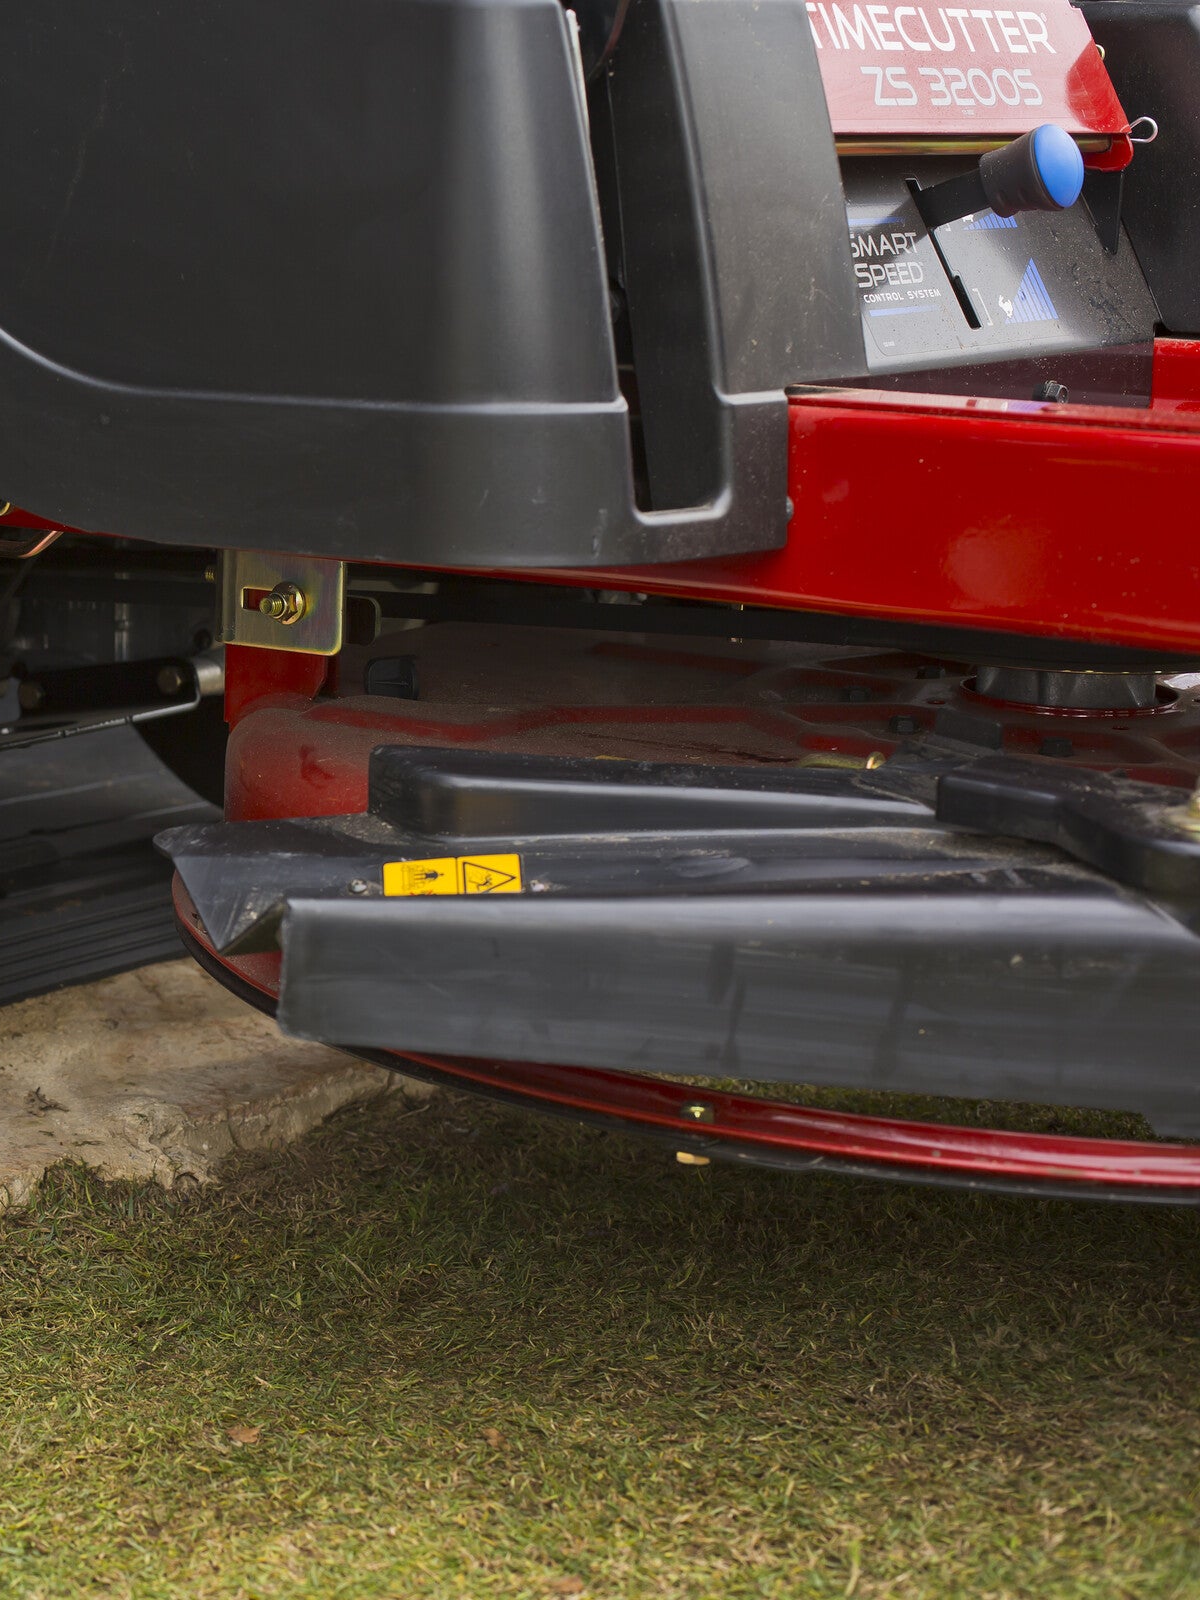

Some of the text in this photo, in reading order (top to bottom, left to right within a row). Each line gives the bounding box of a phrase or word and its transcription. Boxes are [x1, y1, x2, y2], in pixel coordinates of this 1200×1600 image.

[860, 66, 918, 106] ZS
[854, 261, 924, 288] SPEED
[863, 289, 941, 303] CONTROL SYSTEM
